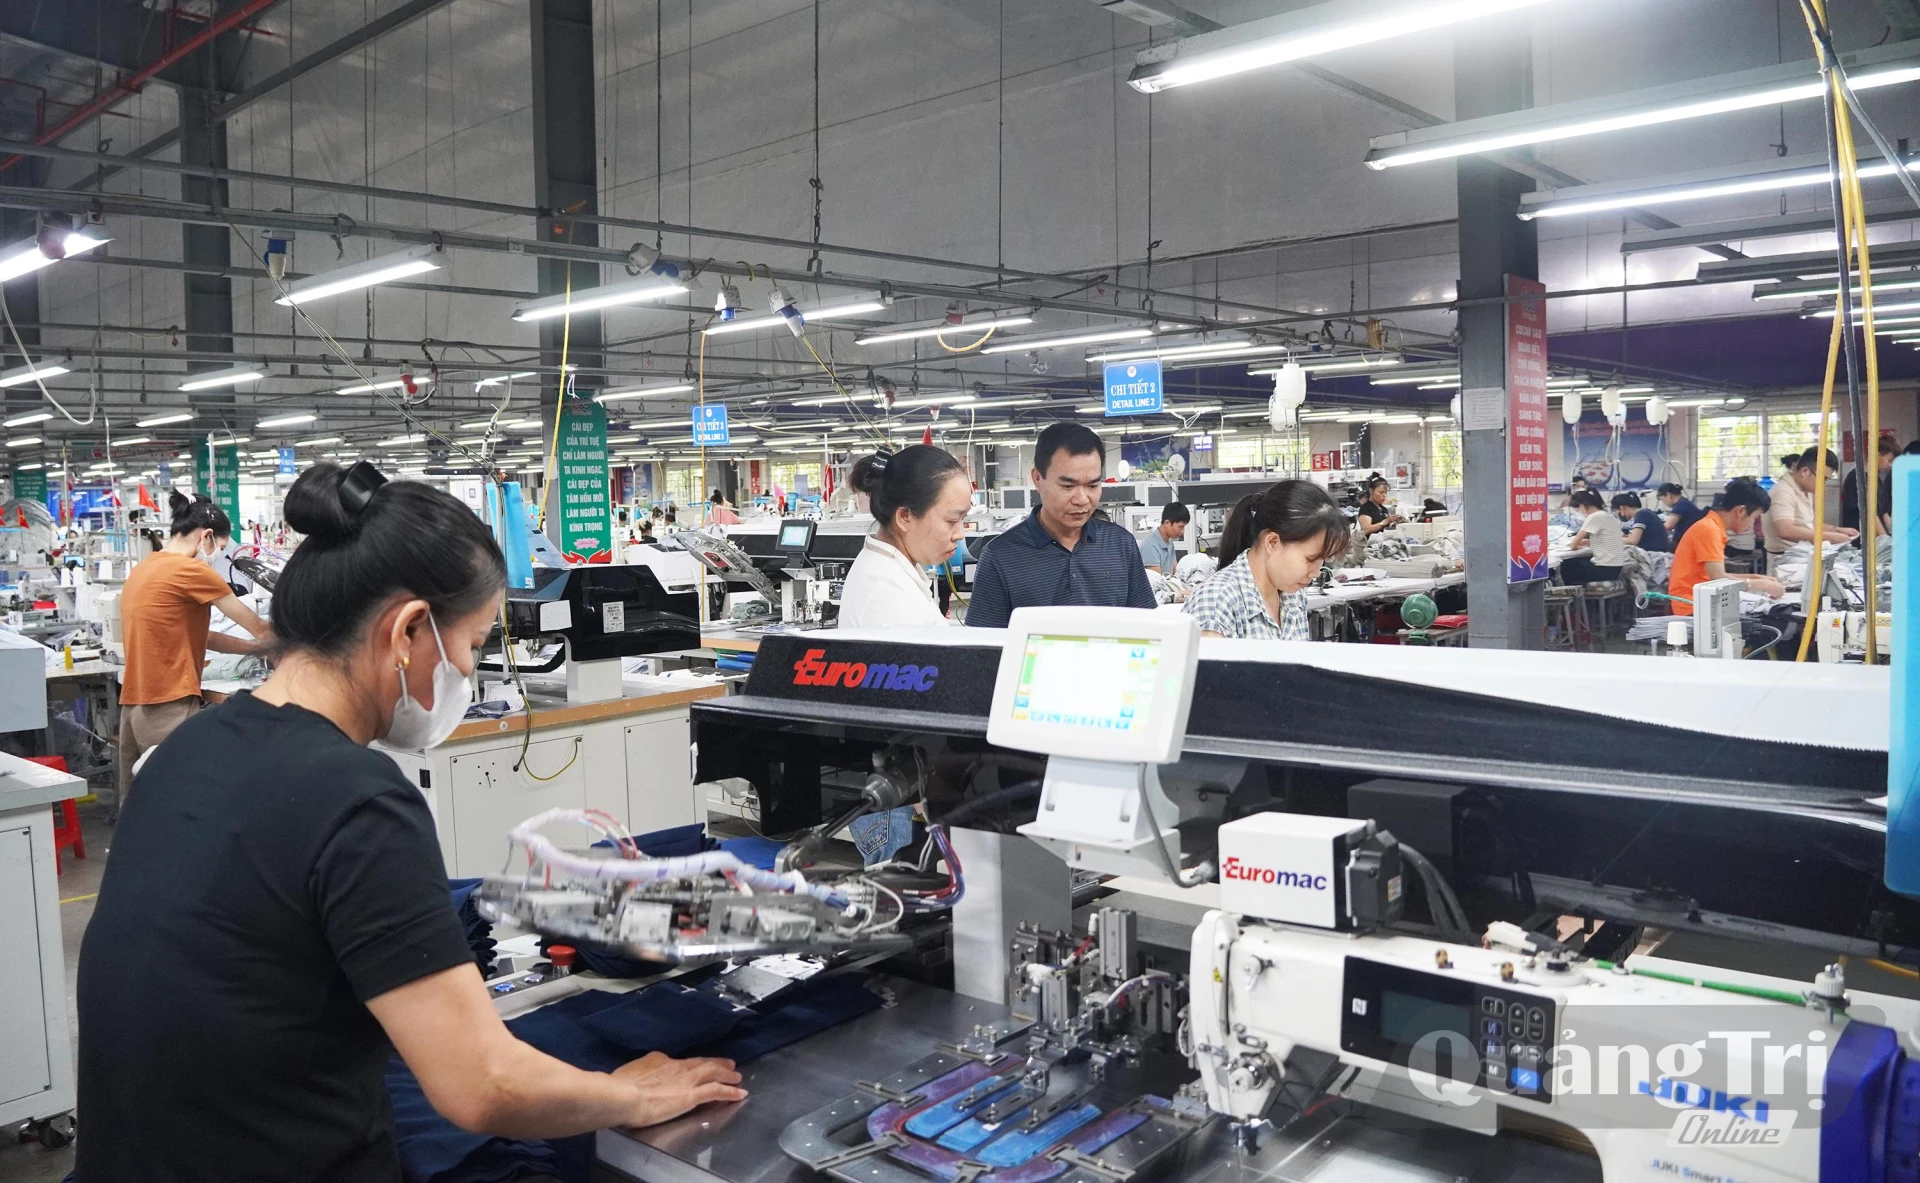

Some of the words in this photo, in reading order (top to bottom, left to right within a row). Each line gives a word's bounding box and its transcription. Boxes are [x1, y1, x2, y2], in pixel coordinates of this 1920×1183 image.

[1110, 384, 1126, 396] CHI
[1128, 378, 1149, 395] TIẾT
[1150, 382, 1156, 393] 2
[1112, 400, 1134, 409] DETAIL
[1135, 398, 1150, 407] LINE
[1150, 398, 1155, 406] 2
[572, 421, 581, 431] CÁI
[583, 422, 593, 433] ĐẸP
[707, 418, 720, 430] TIẾT
[566, 434, 578, 445] CỦA
[580, 436, 588, 445] TRÍ
[589, 436, 599, 447] TUỆ
[563, 448, 572, 460] CHỈ
[574, 450, 585, 460] LÀM
[587, 449, 604, 460] NGƯỜI
[564, 466, 570, 474] TA
[572, 466, 585, 474] KINH
[567, 479, 577, 489] CÁI
[578, 480, 589, 490] ĐẸP
[591, 477, 602, 488] CỦA
[566, 493, 578, 503] TÂM
[593, 492, 604, 502] MỚI
[566, 507, 578, 518] LÀM
[580, 506, 597, 517] NGƯỜI
[598, 508, 605, 516] TA
[569, 522, 583, 532] KÍNH
[585, 522, 603, 532] TRỌNG
[793, 649, 939, 692] Euromac
[1222, 857, 1327, 890] Euromac
[1638, 1078, 1770, 1124] JUKI
[1652, 1159, 1679, 1174] JUKI
[1682, 1166, 1722, 1183] Smart
